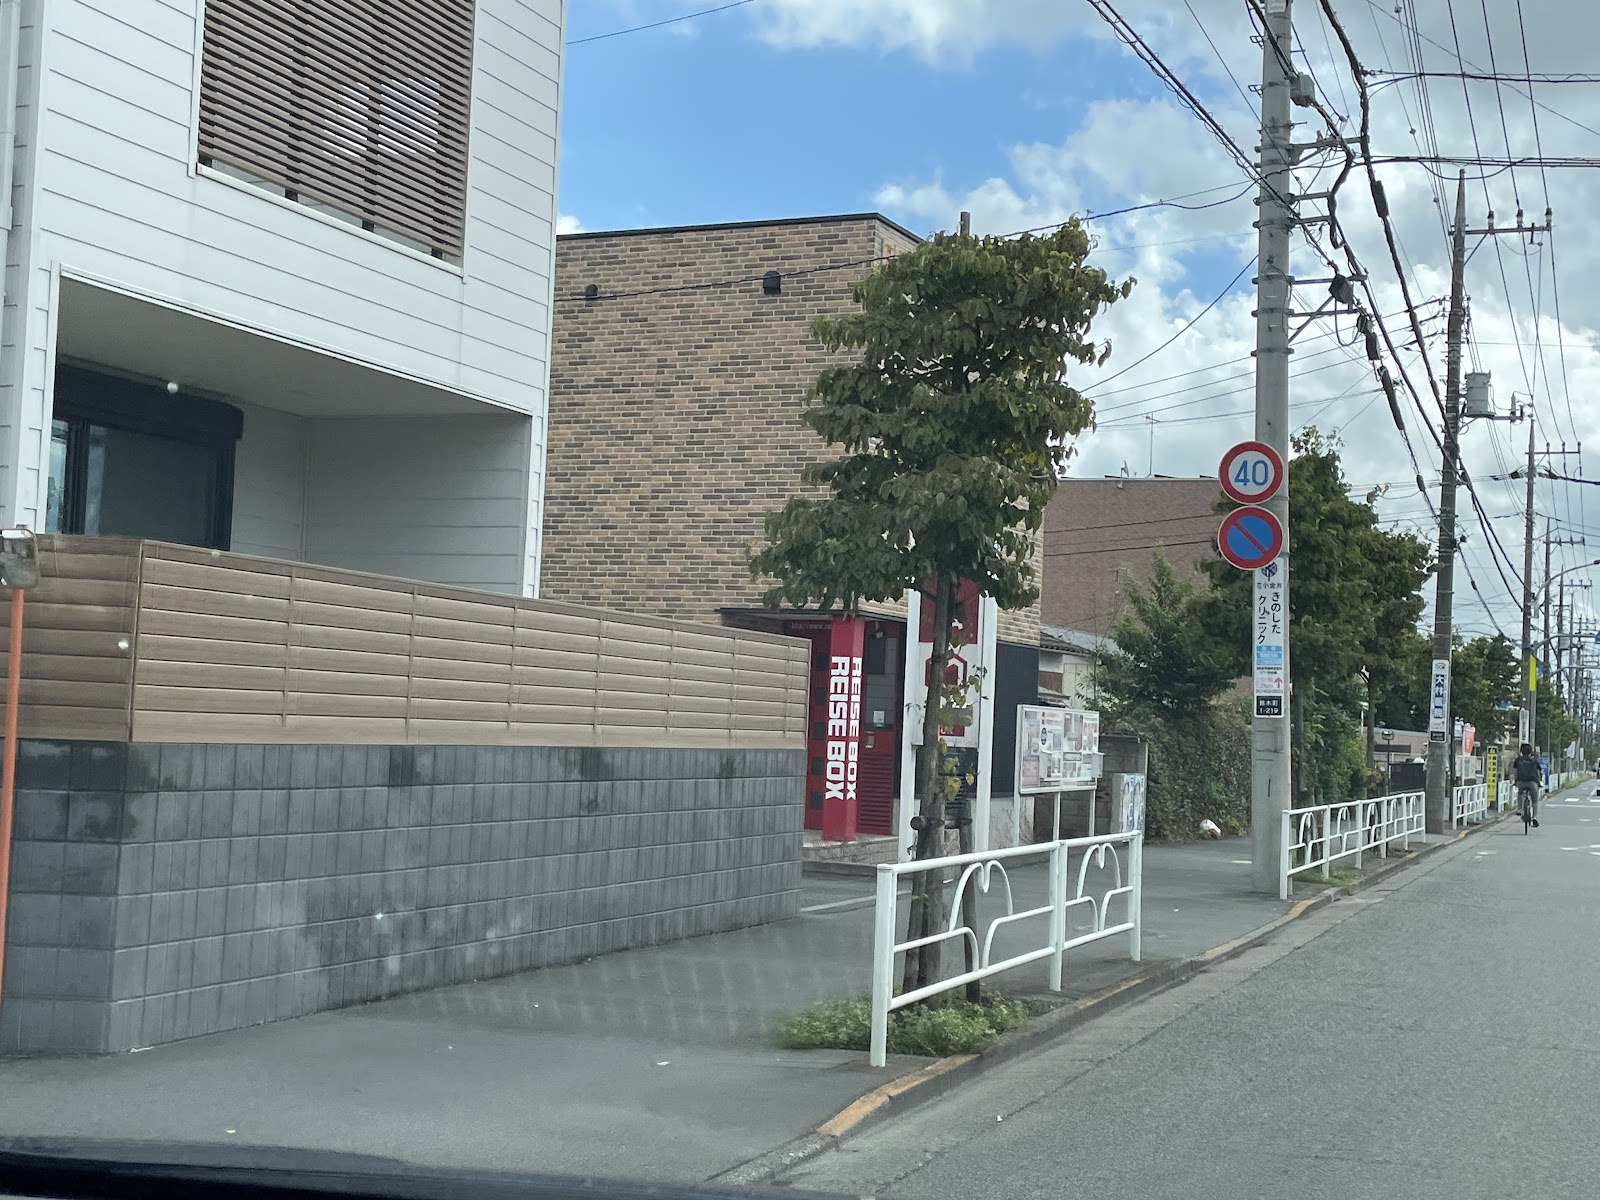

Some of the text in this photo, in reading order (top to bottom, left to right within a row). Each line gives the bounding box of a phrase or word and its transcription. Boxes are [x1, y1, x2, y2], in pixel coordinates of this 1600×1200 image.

[1234, 460, 1269, 487] 40
[1257, 595, 1267, 645] クリニック
[1271, 592, 1281, 634] きのした
[825, 656, 850, 801] REISE BOX
[846, 656, 862, 801] REISE BOX
